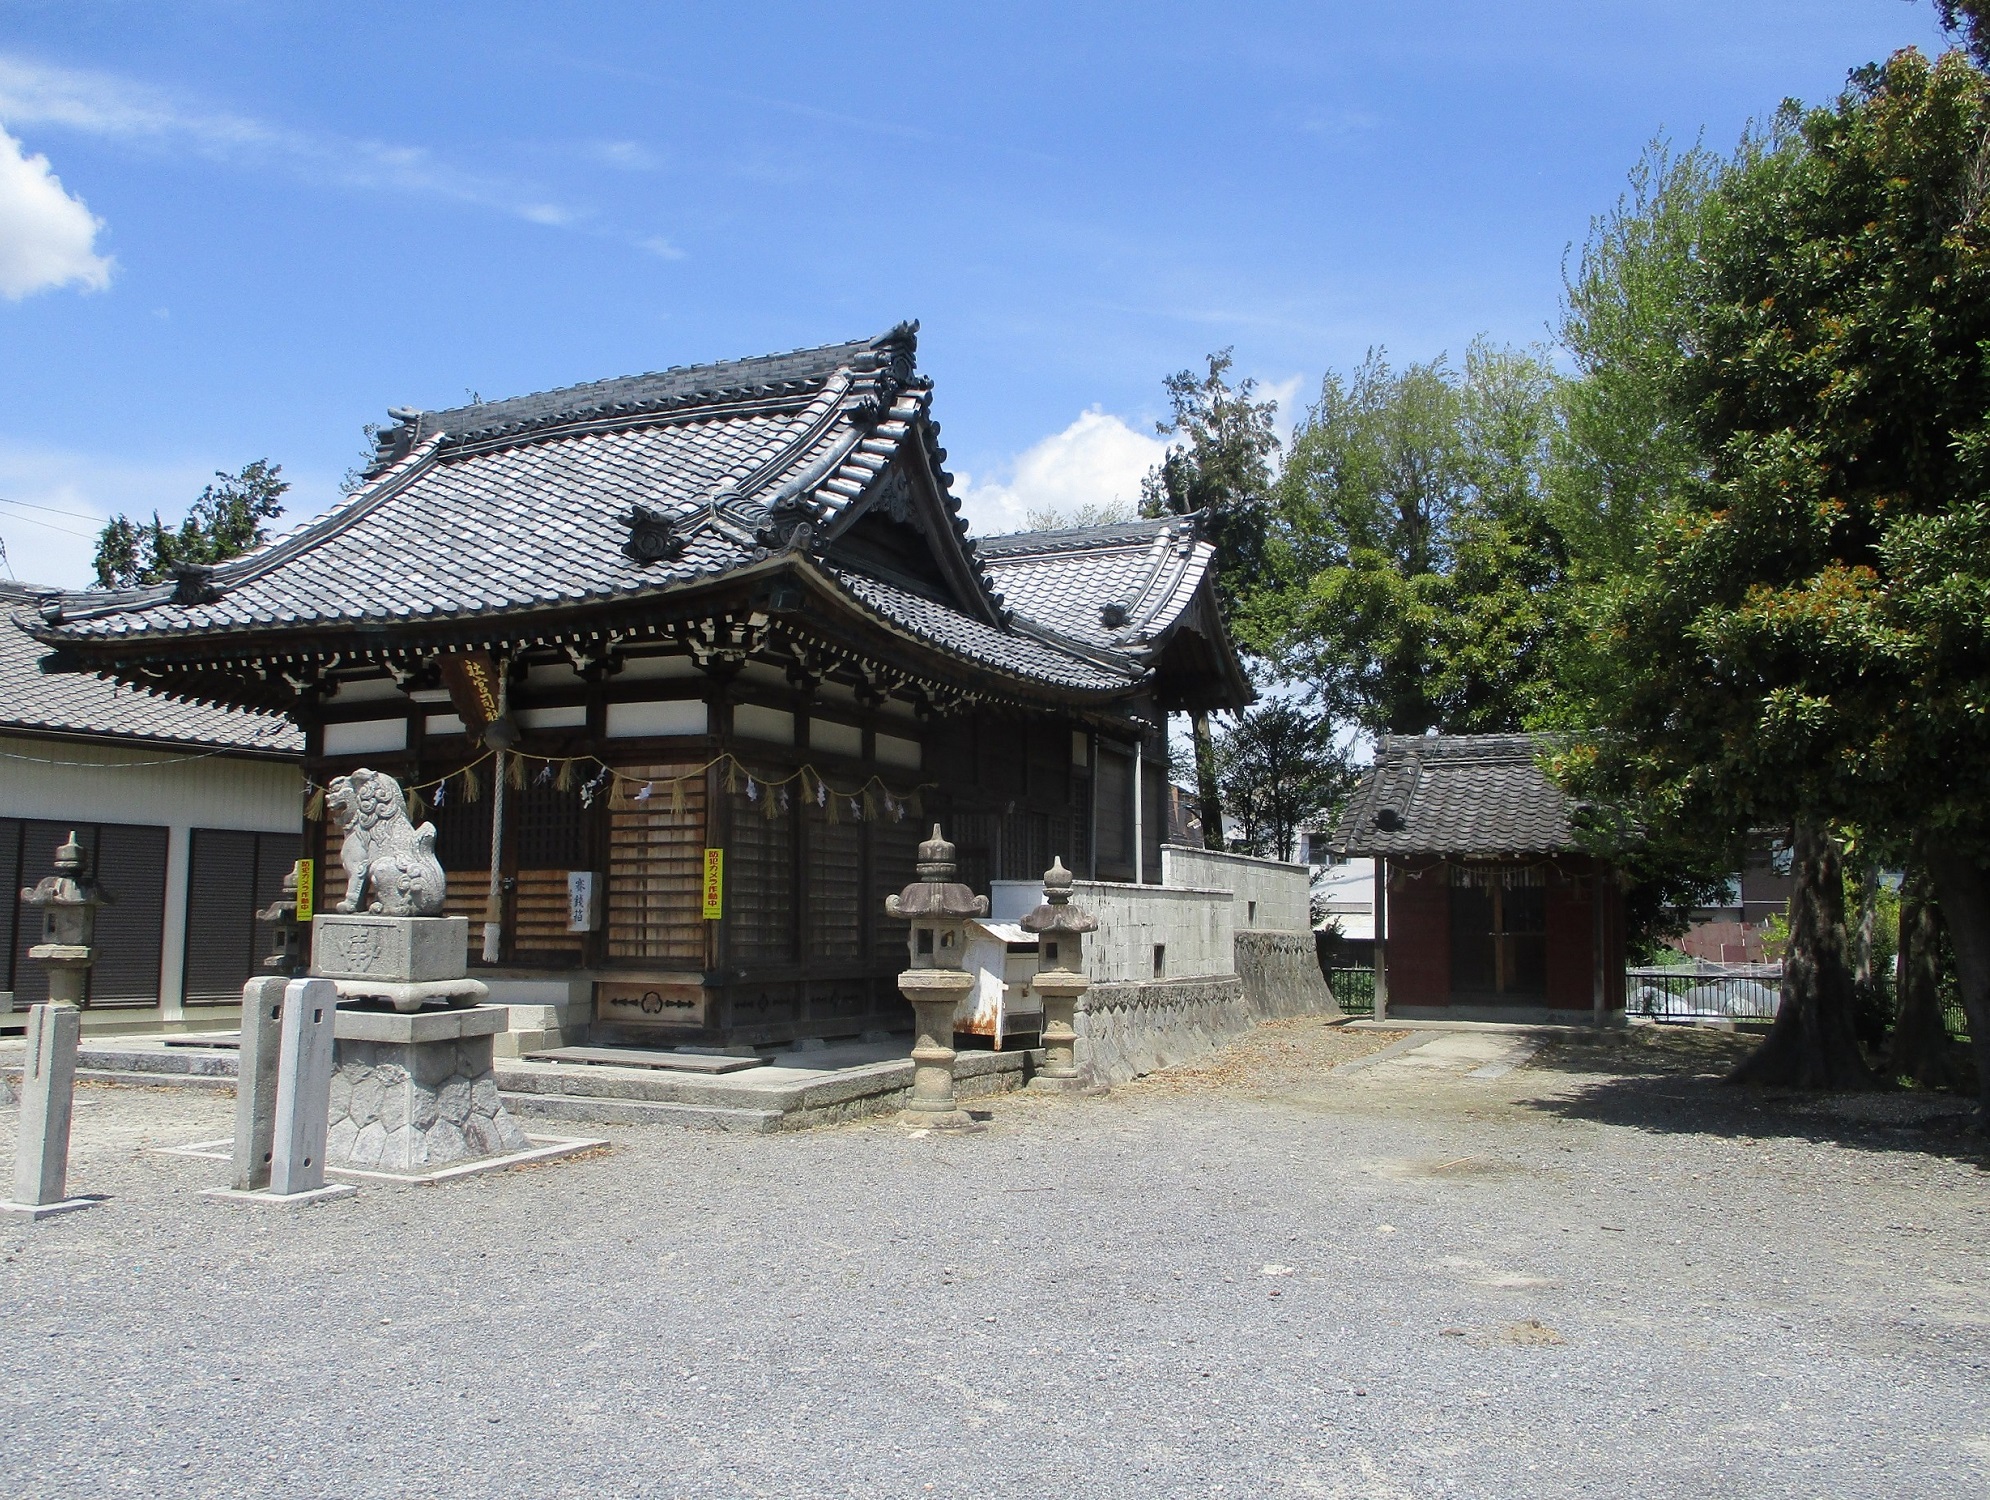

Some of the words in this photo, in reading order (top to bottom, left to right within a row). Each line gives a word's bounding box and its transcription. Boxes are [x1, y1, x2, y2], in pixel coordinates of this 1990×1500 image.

[300, 861, 310, 911] 防犯カメラ作動中
[707, 850, 719, 907] 防犯カメラ作動中
